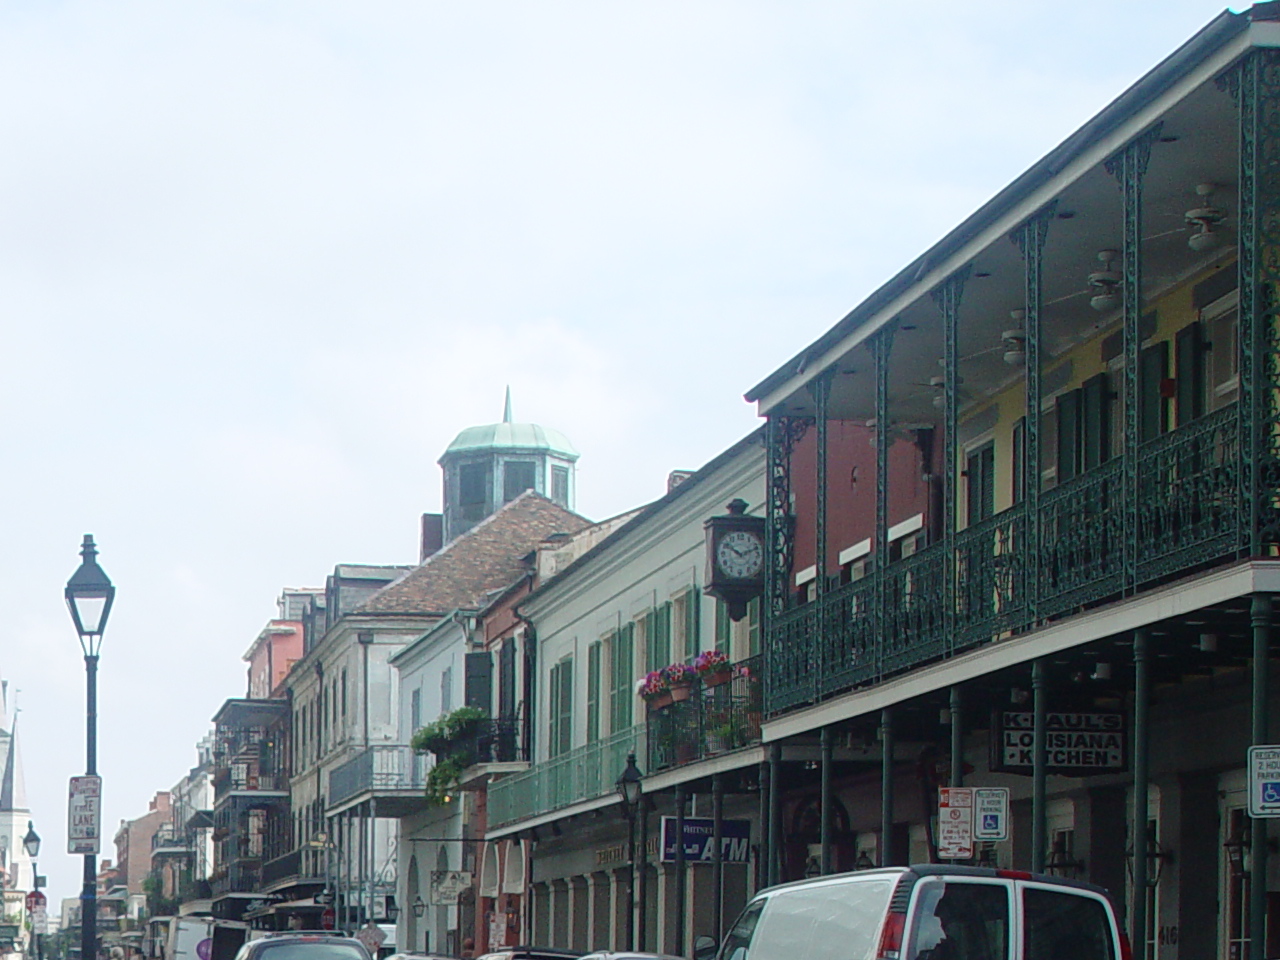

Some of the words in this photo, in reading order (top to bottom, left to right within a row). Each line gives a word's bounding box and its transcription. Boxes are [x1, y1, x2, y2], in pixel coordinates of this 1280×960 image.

[1005, 714, 1119, 727] K-AUL'S
[1006, 734, 1119, 748] LOISIANA
[1020, 751, 1108, 765] KTCHEN
[1266, 761, 1280, 769] HOU
[701, 836, 749, 861] ATM
